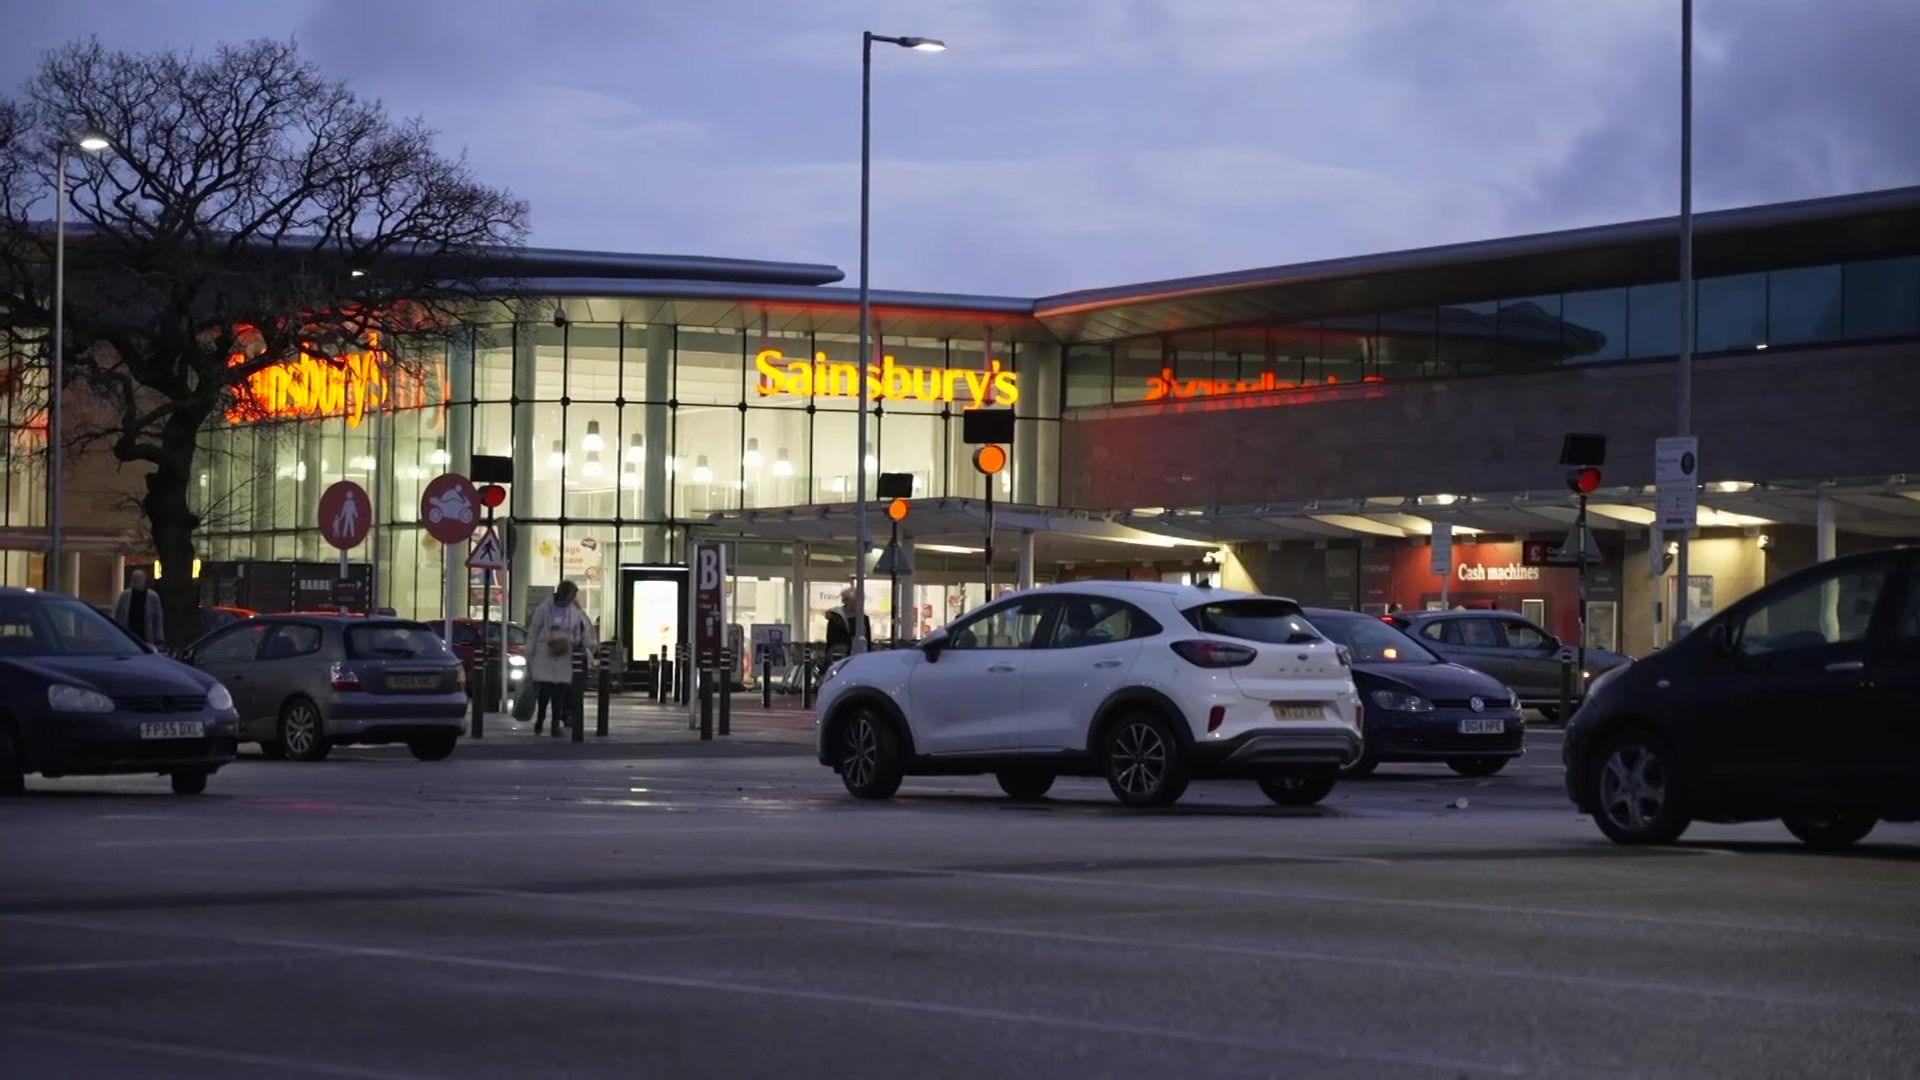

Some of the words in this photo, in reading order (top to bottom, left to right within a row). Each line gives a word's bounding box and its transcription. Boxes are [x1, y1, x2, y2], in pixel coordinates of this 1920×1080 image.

[754, 348, 1021, 409] Sainsbury's
[699, 549, 719, 591] B
[1457, 562, 1485, 581] Cash
[1487, 562, 1540, 580] machines
[145, 722, 177, 736] FP55
